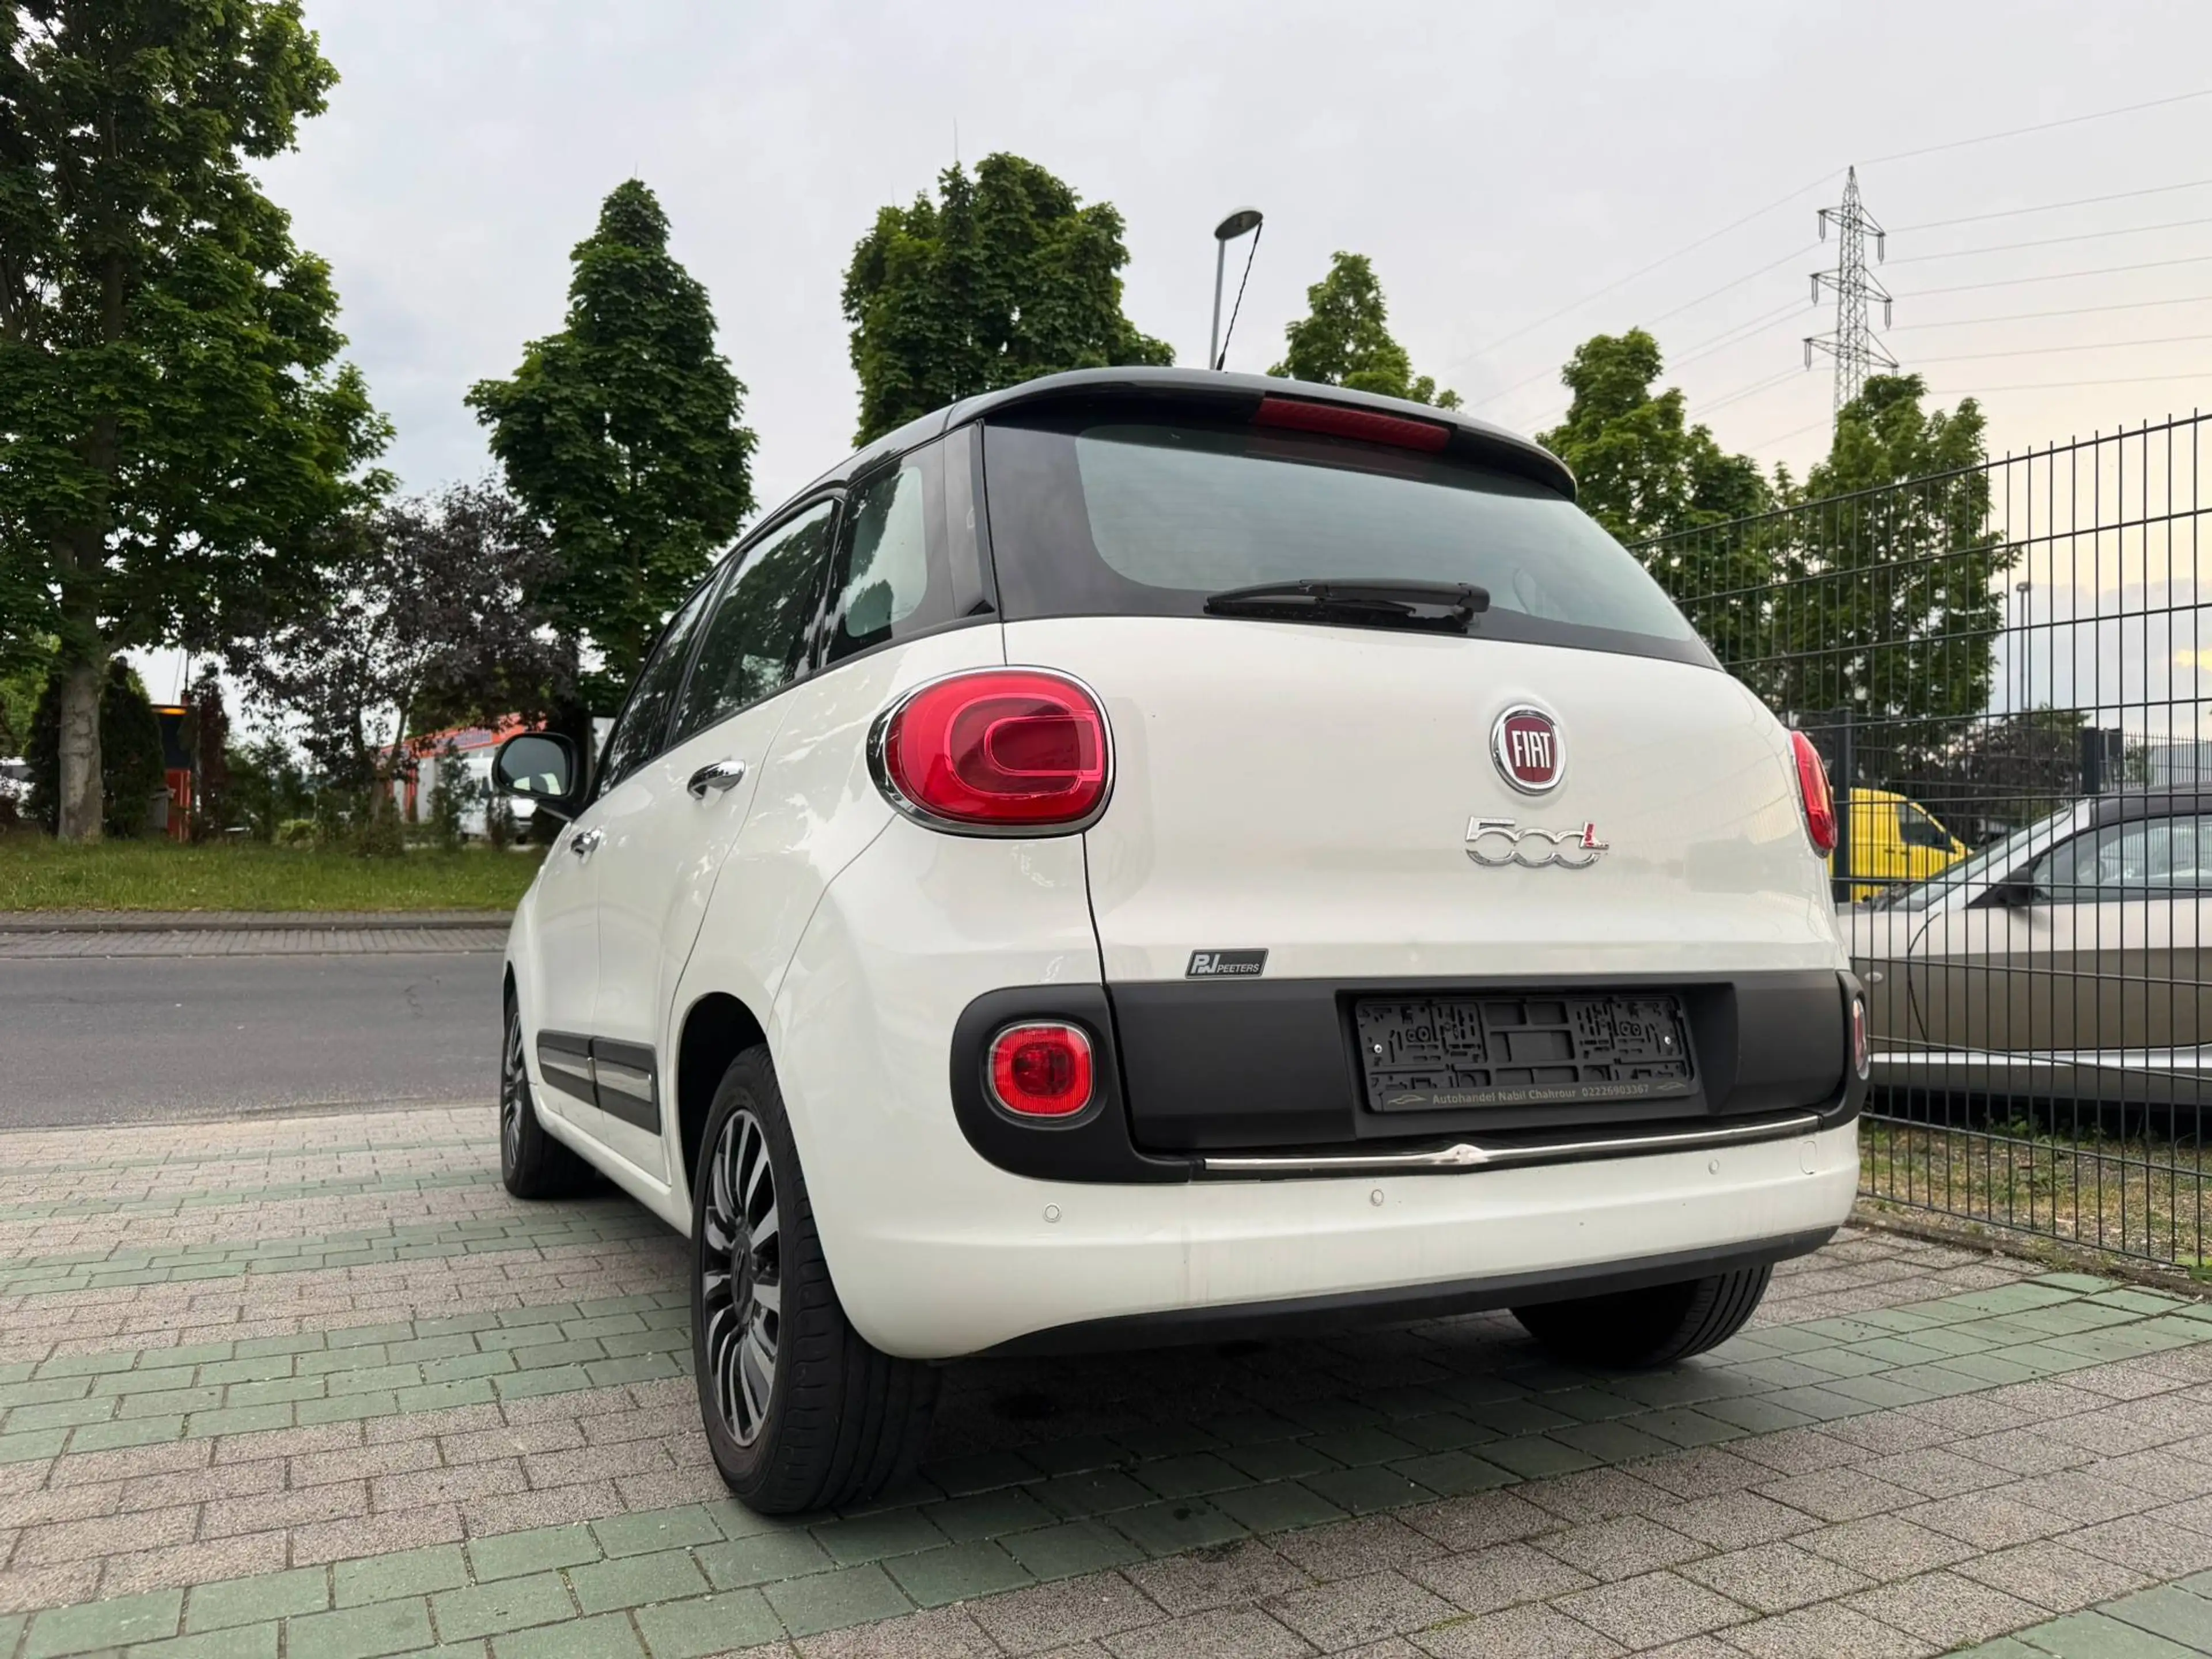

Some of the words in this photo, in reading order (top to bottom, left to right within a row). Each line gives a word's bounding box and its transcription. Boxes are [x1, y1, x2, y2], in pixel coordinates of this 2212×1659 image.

[1512, 730, 1550, 768] FIAT
[1465, 816, 1609, 869] 500L
[1216, 963, 1260, 974] PEETERS
[1433, 1092, 1495, 1104] Autohandel
[1498, 1089, 1526, 1101] Nabil
[1529, 1088, 1577, 1100] Chahrour
